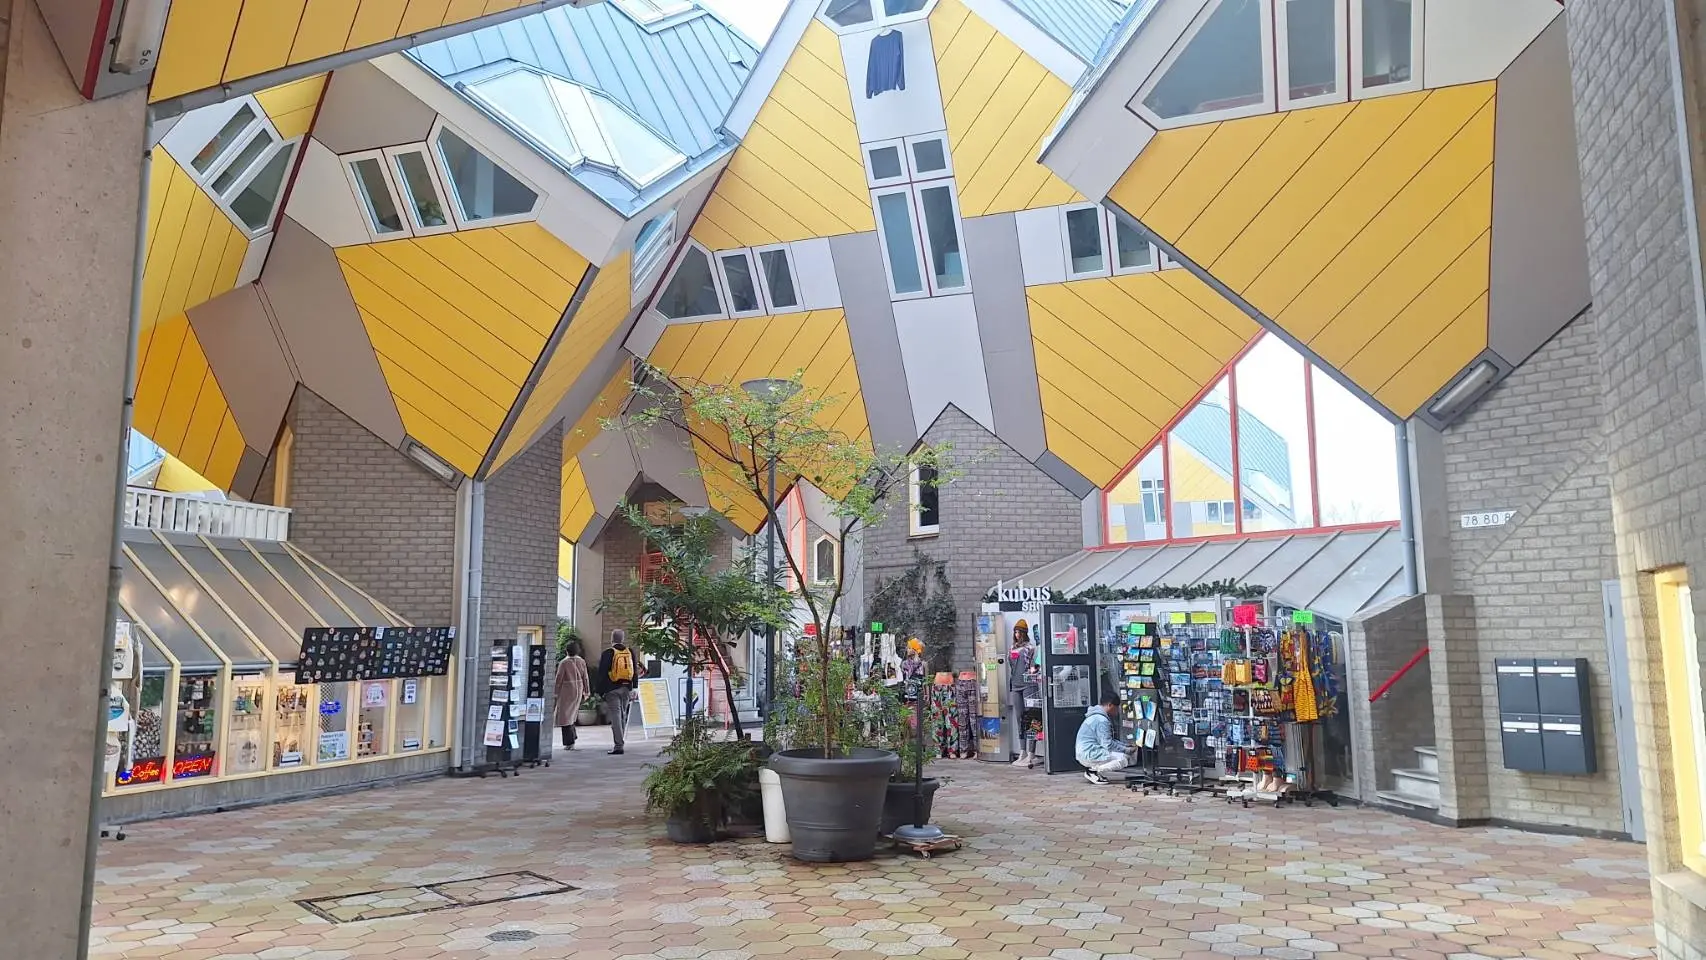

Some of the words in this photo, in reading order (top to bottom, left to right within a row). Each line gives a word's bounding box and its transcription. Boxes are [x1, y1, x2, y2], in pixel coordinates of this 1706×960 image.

[1463, 515, 1479, 526] 78
[1483, 513, 1499, 525] 80
[997, 579, 1051, 602] kubus
[172, 757, 213, 774] OPEN
